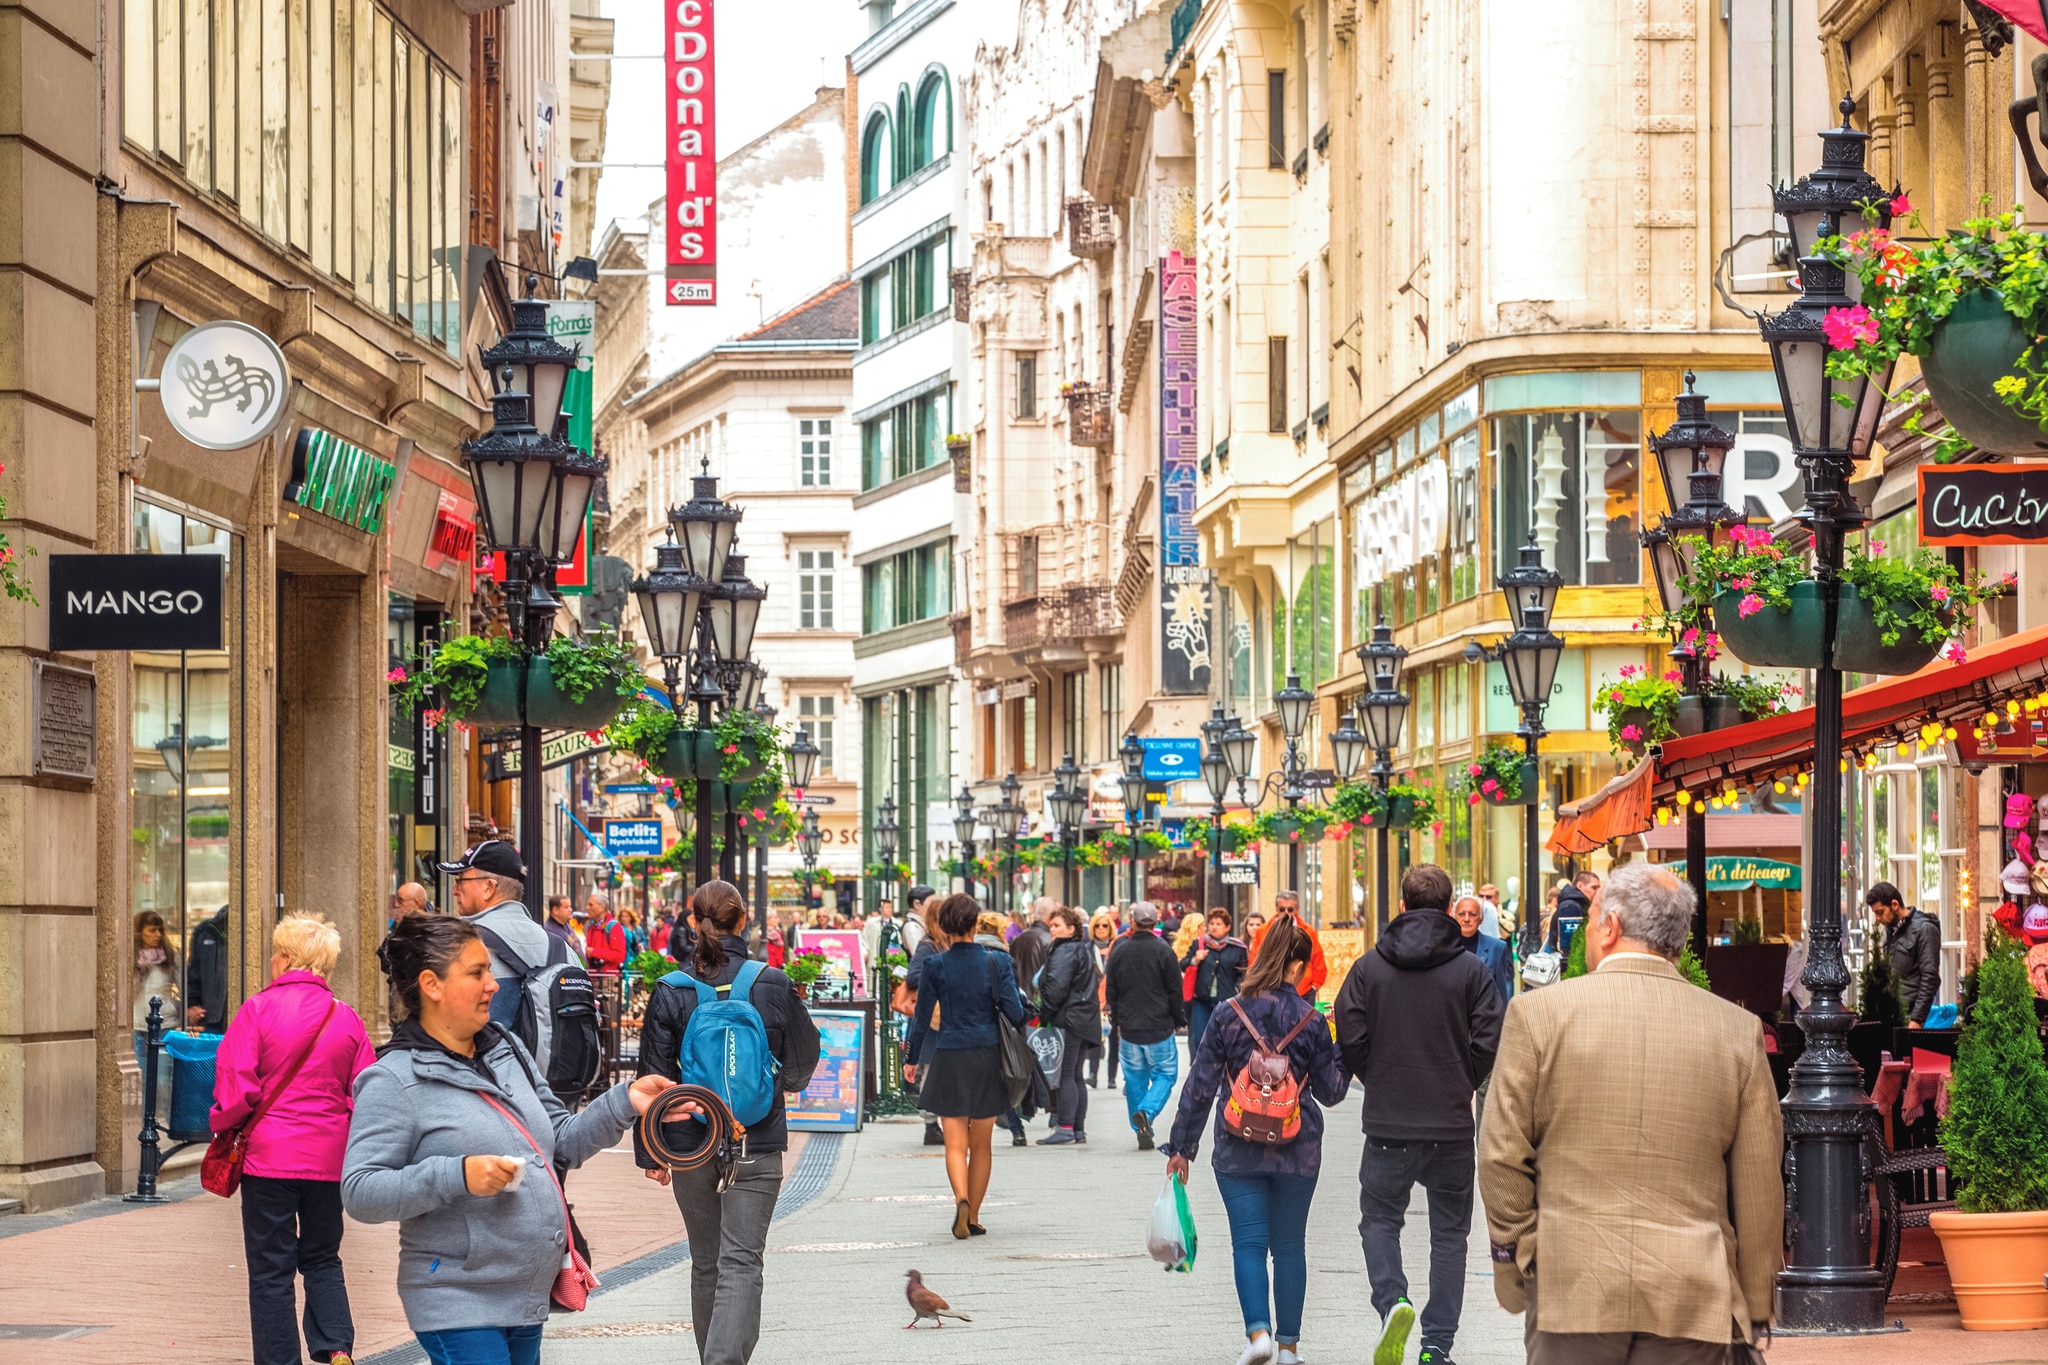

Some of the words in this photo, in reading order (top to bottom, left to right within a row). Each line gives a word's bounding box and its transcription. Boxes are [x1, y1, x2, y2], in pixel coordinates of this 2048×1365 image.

[67, 590, 203, 615] MANGO
[1492, 683, 1563, 696] RESD
[609, 823, 659, 838] Berlitz
[609, 837, 659, 847] Nyelviskola
[1730, 862, 1791, 882] delicacys
